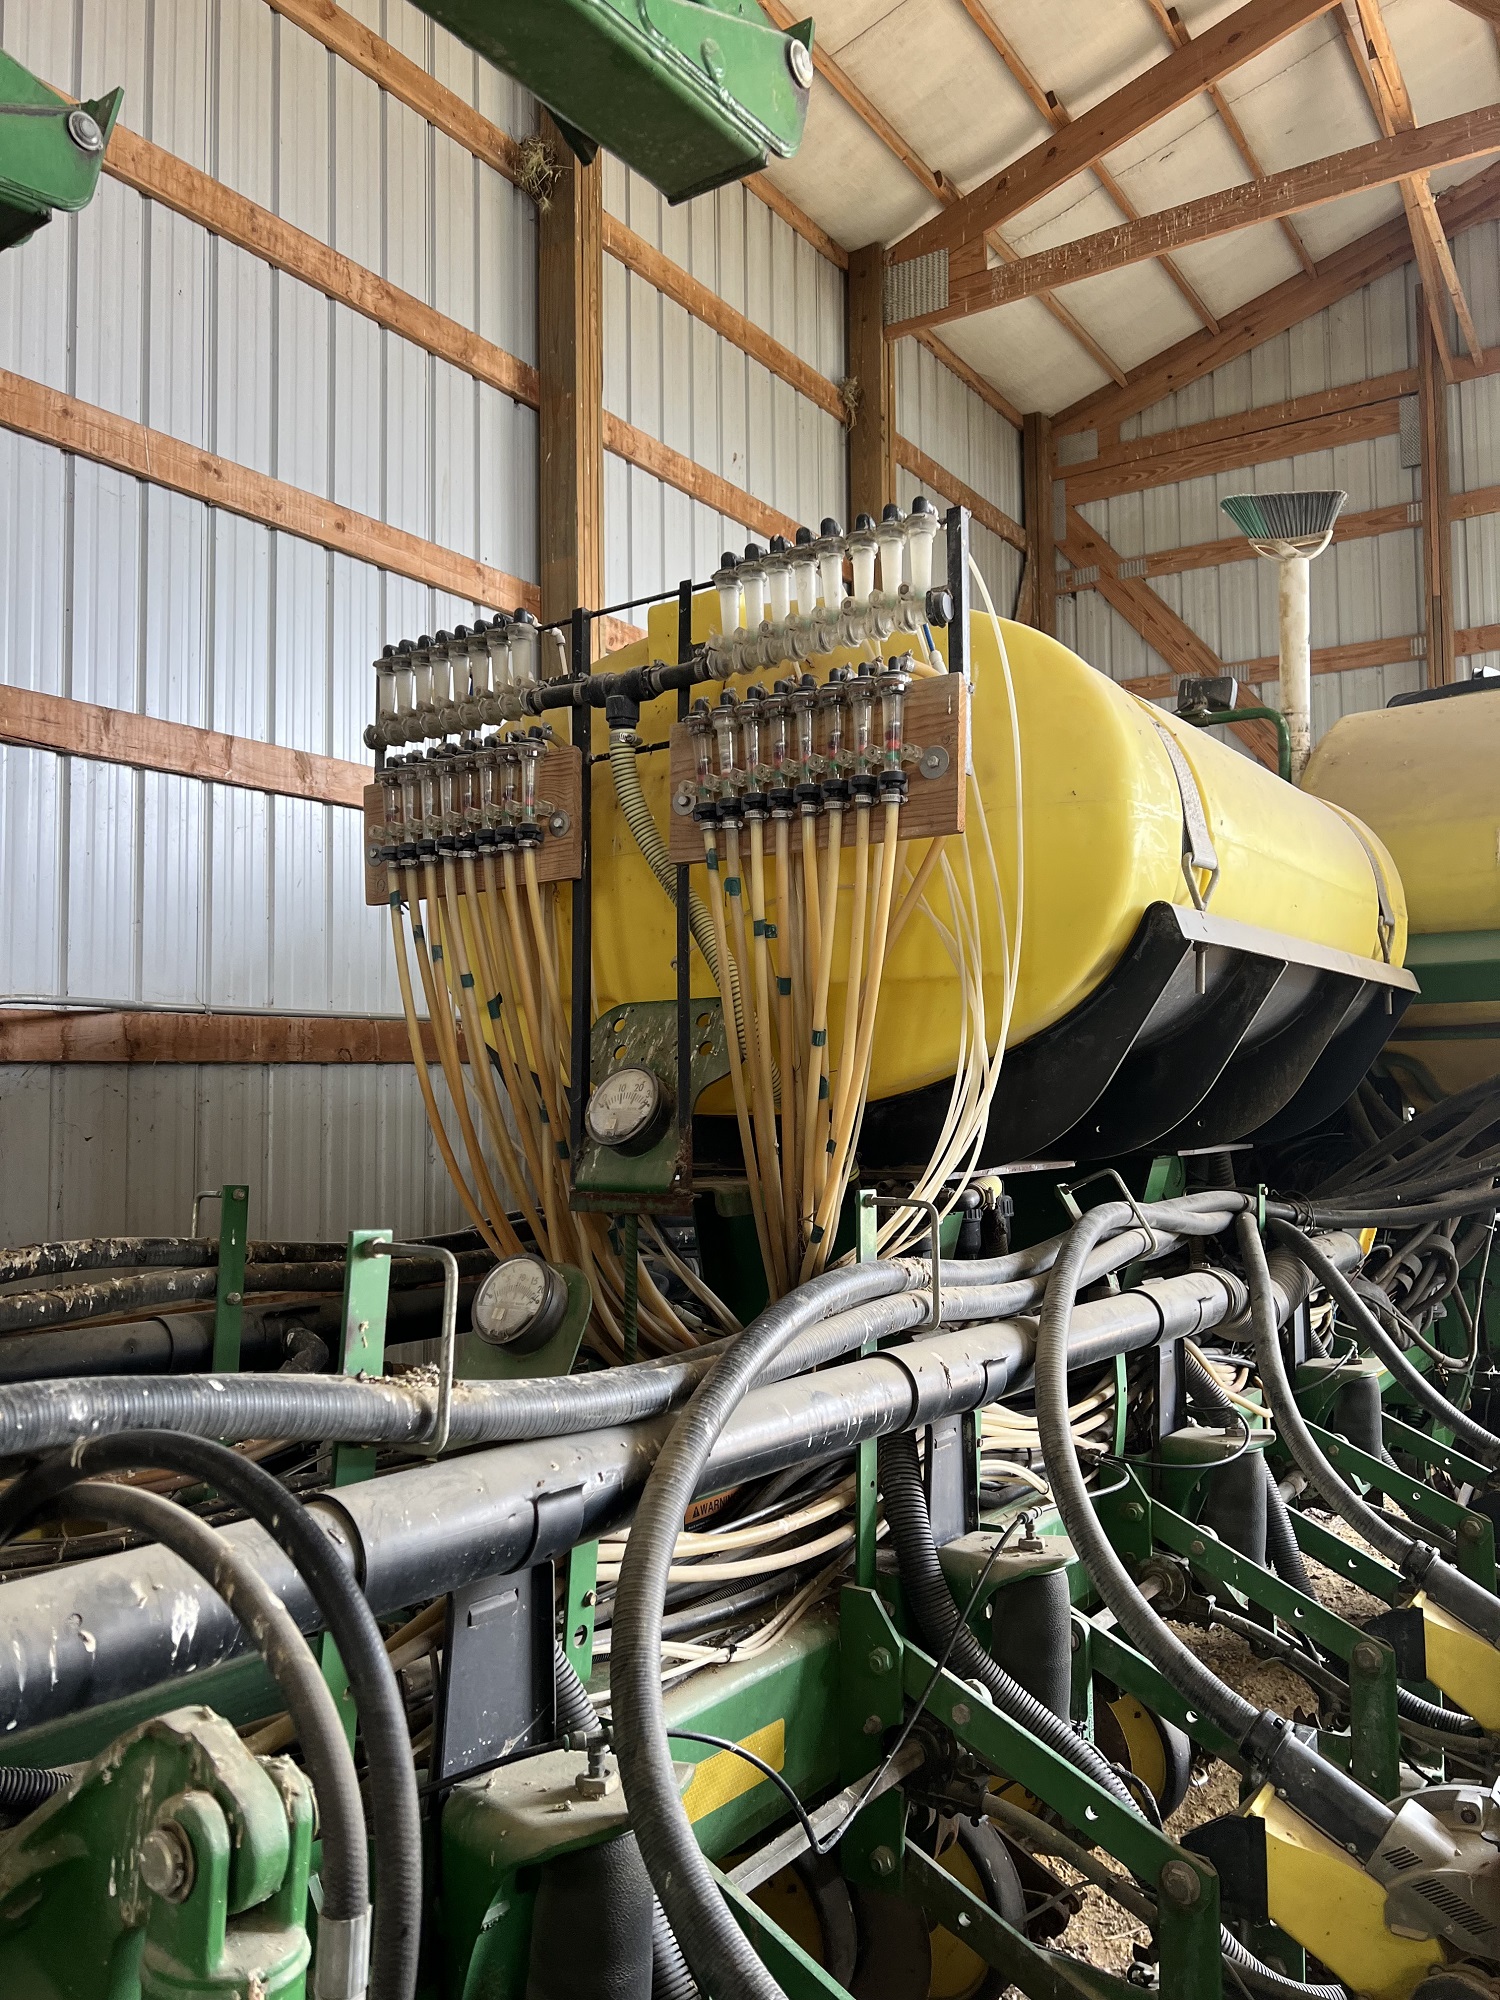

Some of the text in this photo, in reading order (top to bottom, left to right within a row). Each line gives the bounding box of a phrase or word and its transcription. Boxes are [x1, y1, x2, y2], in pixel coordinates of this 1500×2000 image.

[618, 1083, 627, 1092] 10
[633, 1083, 645, 1092] 20
[530, 1276, 539, 1285] 15
[700, 1493, 737, 1515] WARNIN
